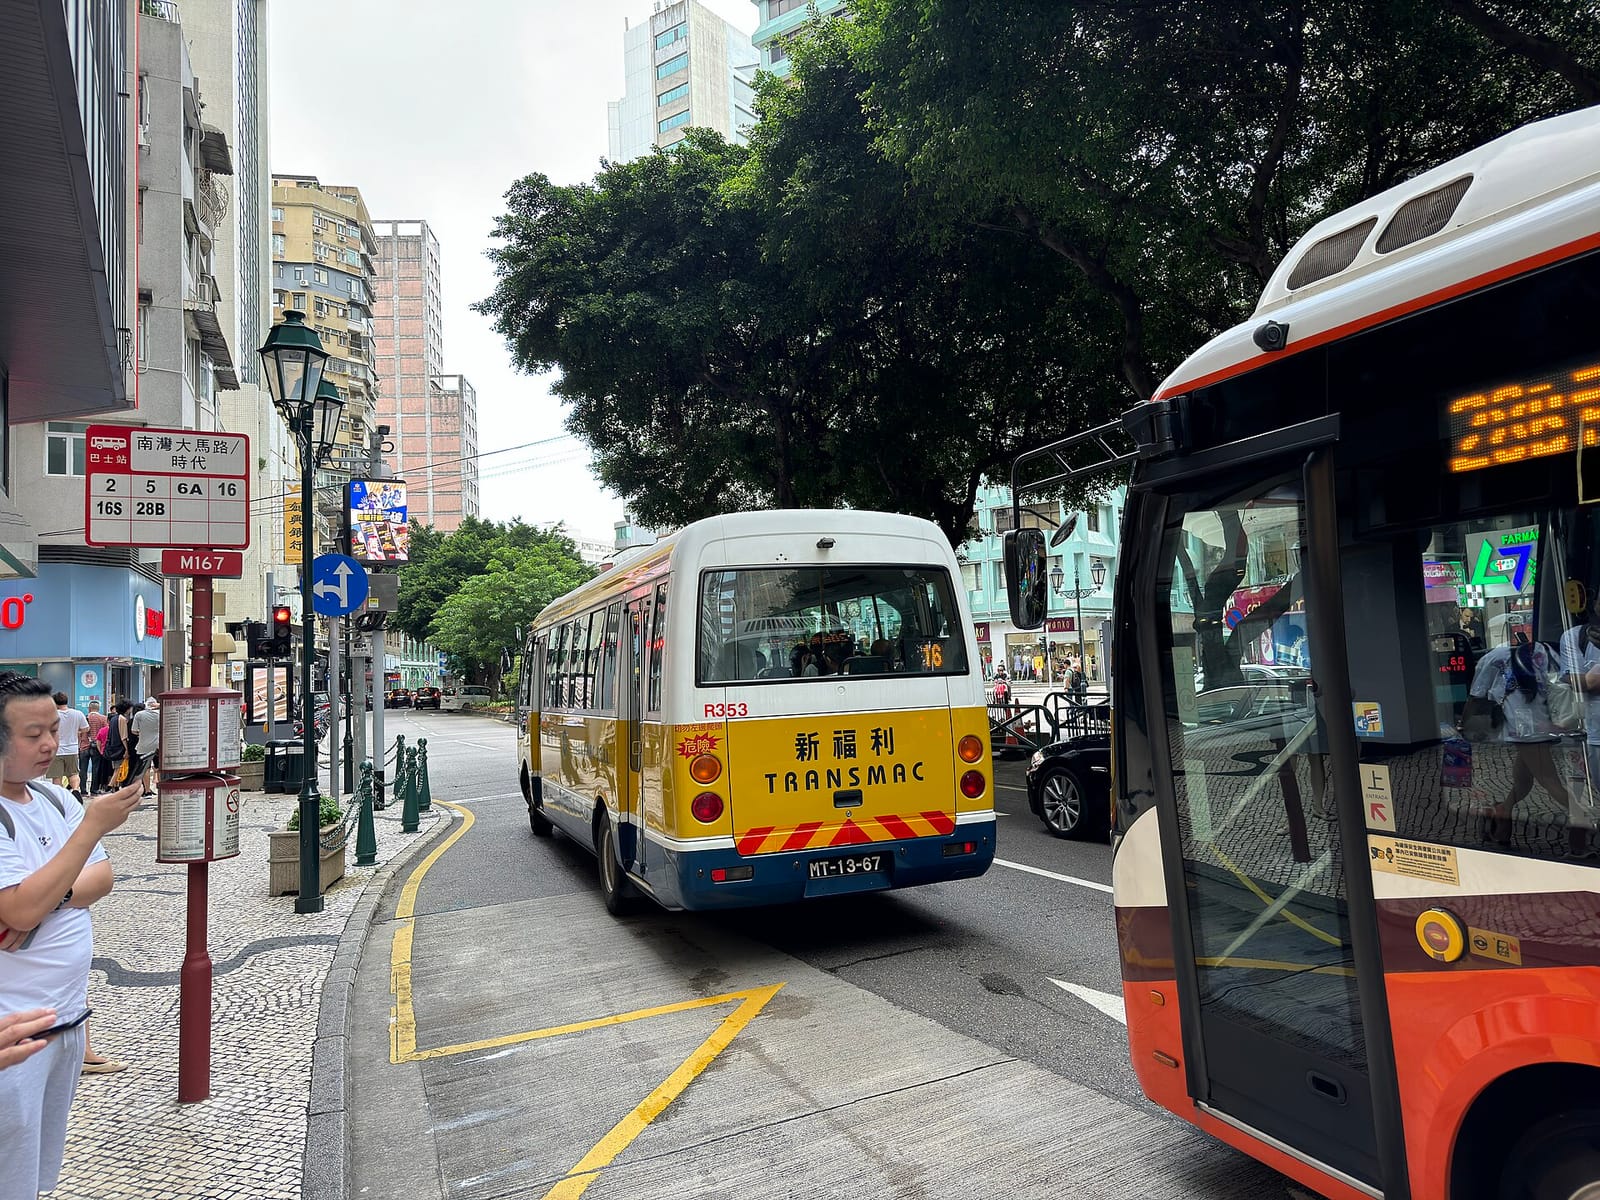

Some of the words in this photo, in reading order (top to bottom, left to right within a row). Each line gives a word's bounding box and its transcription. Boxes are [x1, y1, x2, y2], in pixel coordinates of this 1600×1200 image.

[137, 436, 240, 455] 南灣大馬路/
[90, 453, 127, 465] 巴士站
[171, 455, 207, 470] 時代
[106, 479, 116, 492] 2
[146, 480, 156, 493] 5
[177, 483, 203, 495] 6A
[218, 483, 237, 496] 16
[97, 501, 122, 515] 16S
[136, 502, 165, 515] 28B
[1501, 528, 1539, 544] FARMÁ
[180, 556, 225, 570] M167
[922, 643, 944, 668] 16
[704, 703, 748, 718] R353
[684, 739, 711, 753] 危險
[795, 726, 895, 762] 新福利
[764, 761, 925, 794] TRANSMAC
[1367, 770, 1385, 791] 上
[808, 856, 881, 878] MT-13-67
